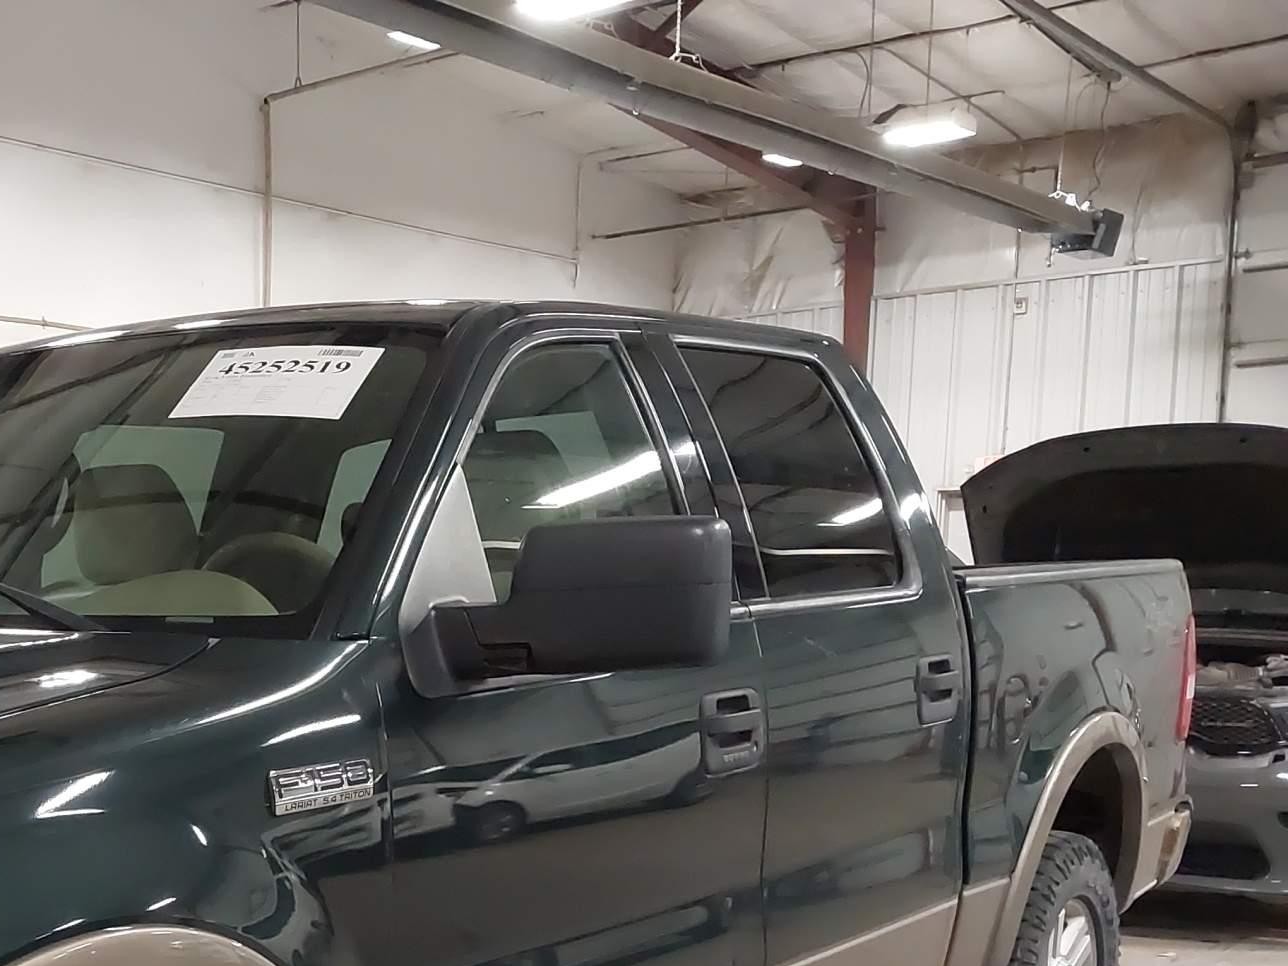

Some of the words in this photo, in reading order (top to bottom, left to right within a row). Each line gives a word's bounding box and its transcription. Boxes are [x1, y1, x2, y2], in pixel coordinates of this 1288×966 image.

[218, 359, 352, 376] 45252519
[285, 799, 317, 812] LARIAT
[340, 788, 372, 801] TRITON
